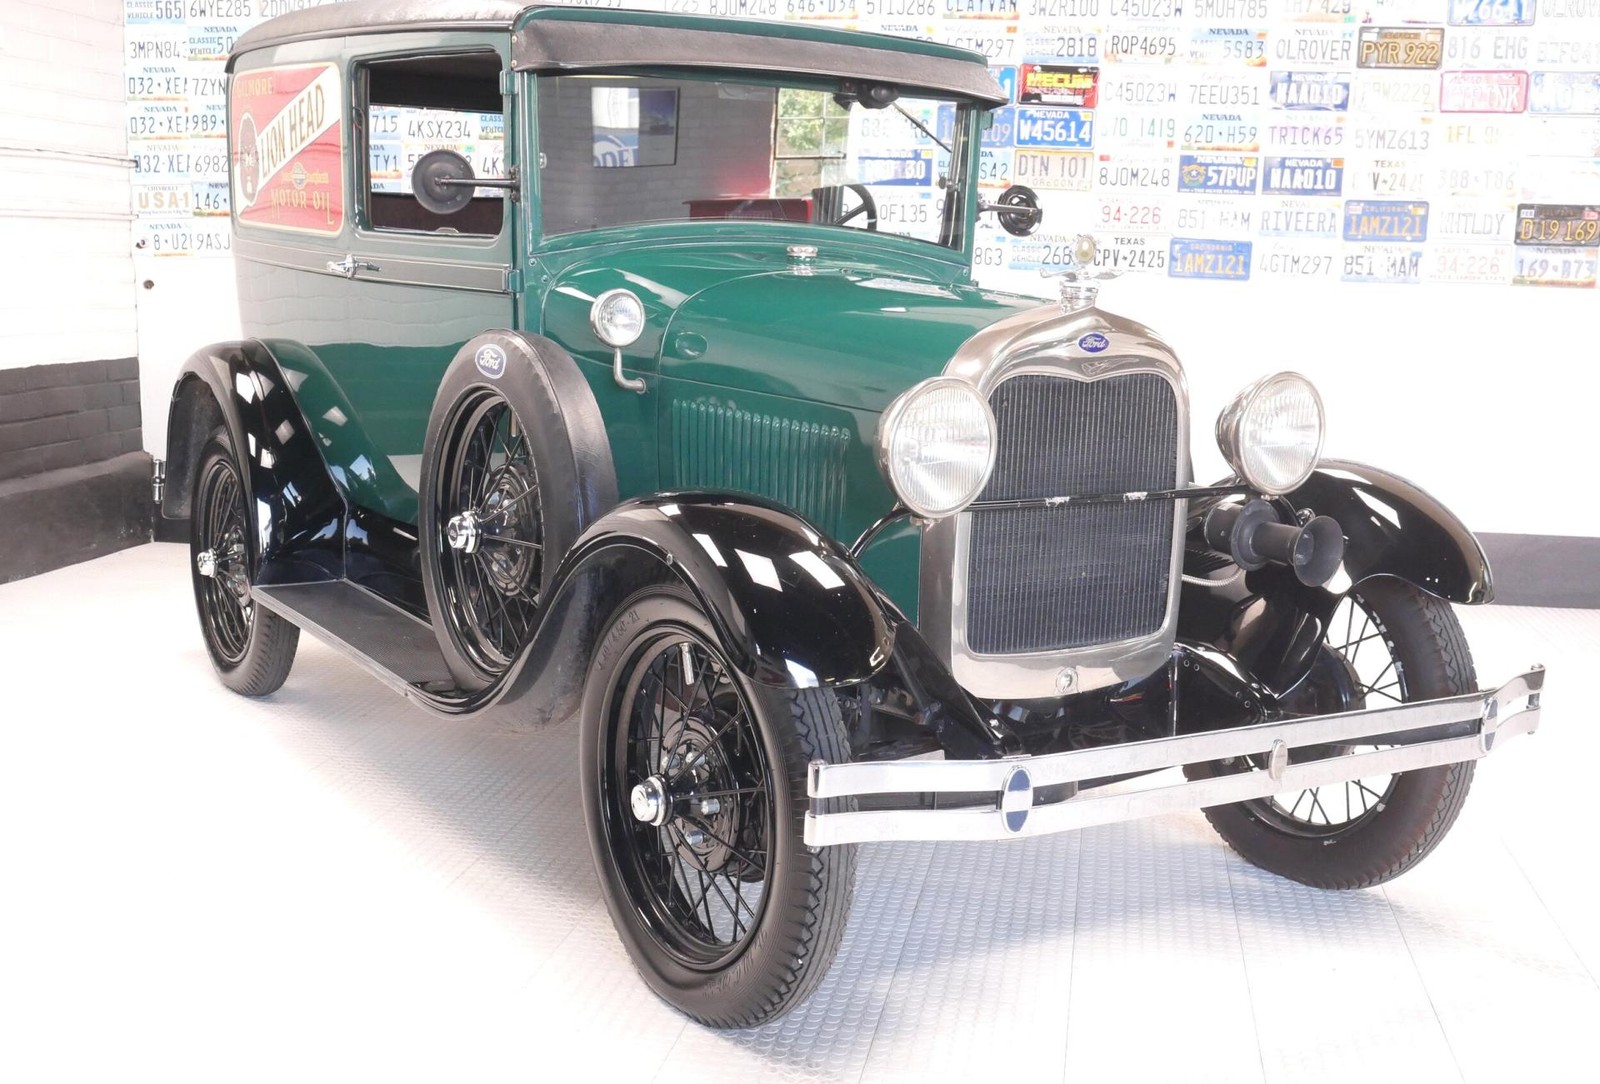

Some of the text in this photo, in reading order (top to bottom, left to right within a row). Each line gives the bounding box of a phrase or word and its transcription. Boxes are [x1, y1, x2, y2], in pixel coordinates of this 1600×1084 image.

[126, 1, 154, 9] CLASSIC
[189, 0, 252, 18] 6WYE285
[880, 24, 919, 32] NEVADA
[1208, 27, 1249, 36] NEVADA
[129, 40, 187, 59] 3MPN84
[189, 47, 216, 55] VEHICLE
[1056, 37, 1097, 58] 2818
[1361, 41, 1439, 64] PYR 922
[142, 66, 176, 74] NEVADA
[236, 76, 273, 98] GILMORE
[1104, 81, 1177, 103] C45023W
[1188, 84, 1261, 106] 7EEU351
[144, 105, 178, 113] NEVADA
[1036, 110, 1071, 120] NEVADA
[1201, 113, 1242, 122] NEVADA
[192, 114, 218, 132] 989
[261, 84, 326, 178] LION HEAD
[371, 115, 399, 133] 715
[407, 119, 472, 139] 4KSX234
[1018, 118, 1092, 143] W45614
[1268, 125, 1344, 146] TRICK65
[1017, 154, 1087, 179] DTN 101
[1285, 159, 1325, 168] NEVADA
[1206, 166, 1256, 188] 57PUP
[194, 193, 220, 210] 146
[270, 186, 335, 225] MOTOR OIL
[149, 223, 182, 231] NEVADA
[1259, 209, 1338, 233] RIVEERA
[1349, 215, 1422, 237] 1AMZ121
[1538, 220, 1560, 241] 19
[1564, 220, 1598, 241] 169
[1029, 235, 1067, 244] NEVADA
[1113, 237, 1145, 246] TEXAS
[1174, 253, 1247, 276] 1AMZ121
[1082, 336, 1106, 348] Ford
[479, 348, 501, 370] Ford
